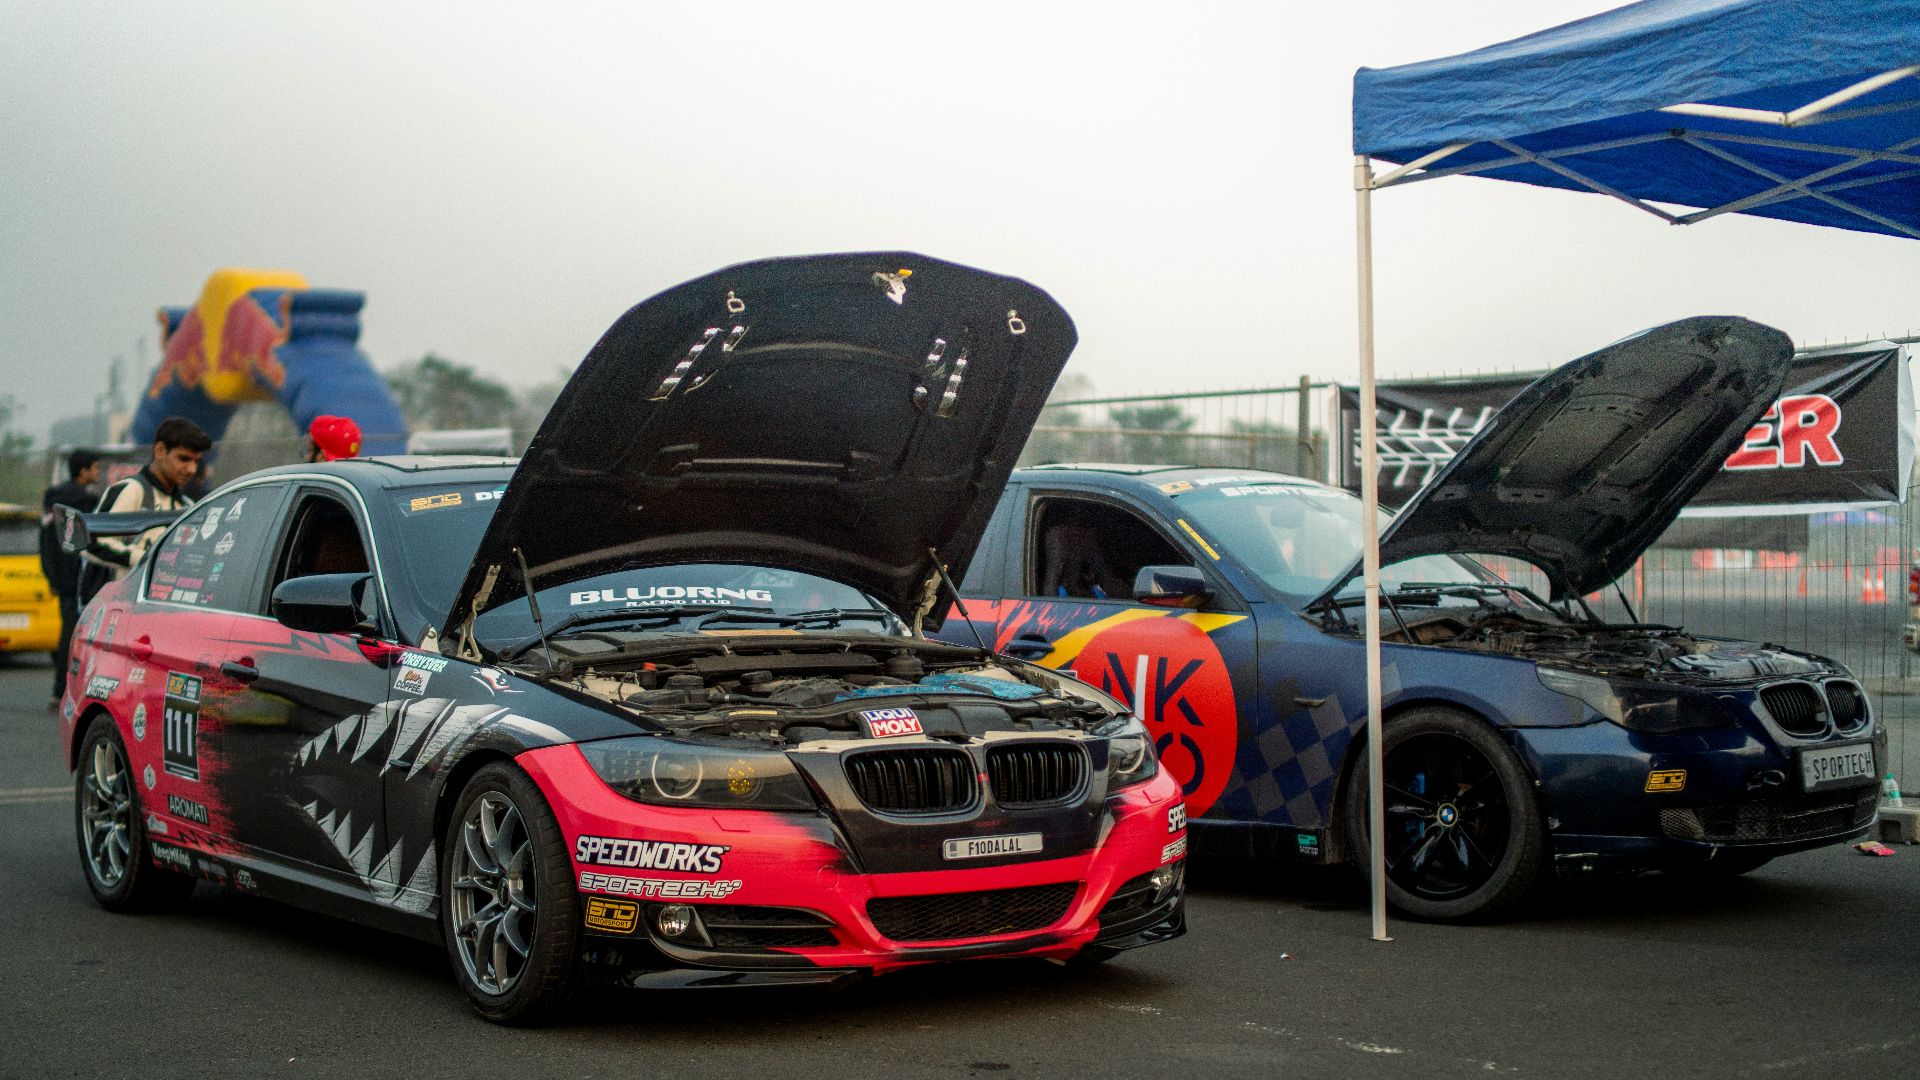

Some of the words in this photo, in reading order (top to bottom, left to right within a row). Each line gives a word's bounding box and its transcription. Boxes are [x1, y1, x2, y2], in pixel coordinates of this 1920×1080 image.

[570, 586, 772, 605] BLUORNG
[863, 708, 915, 721] LIQUI
[165, 707, 194, 757] 111
[872, 718, 917, 736] MOLY
[1813, 751, 1873, 780] SPORTECH
[579, 871, 742, 898] SPORTECH
[587, 917, 633, 929] MOTORSPORT
